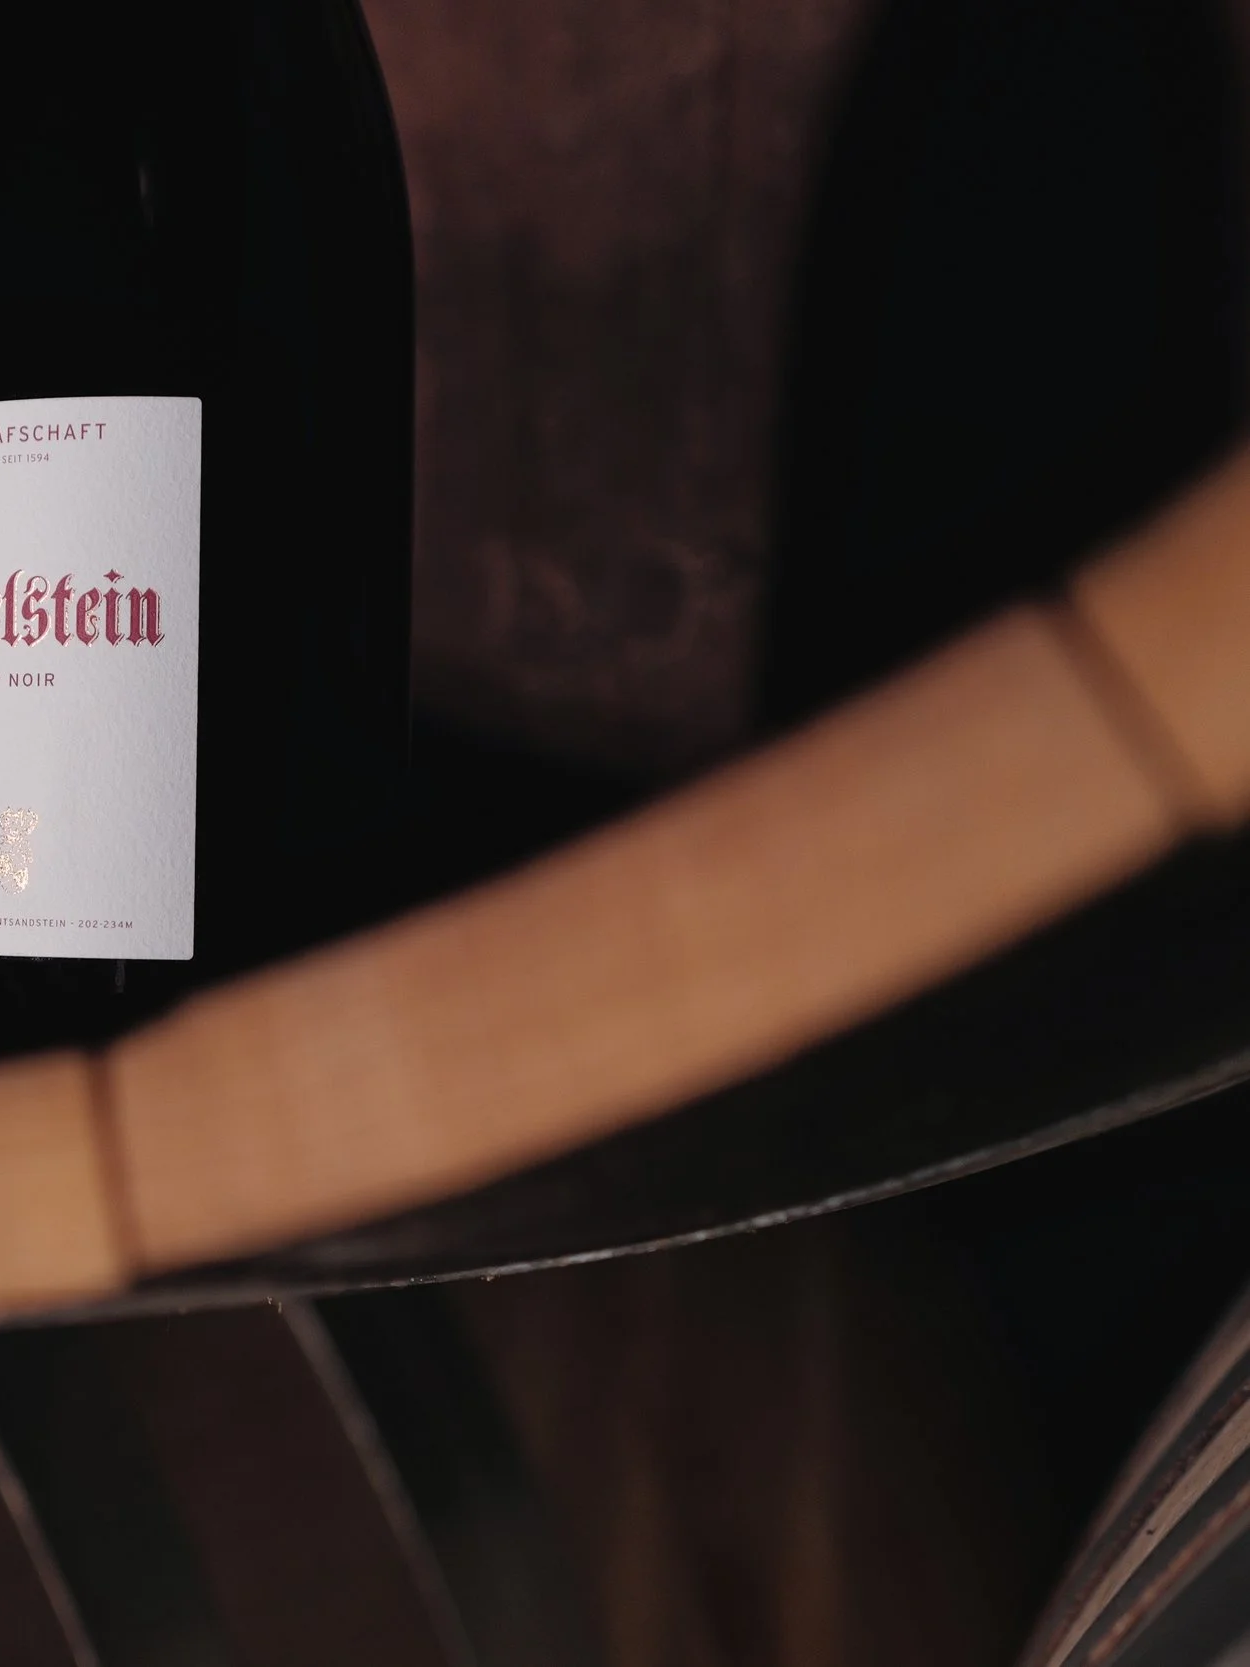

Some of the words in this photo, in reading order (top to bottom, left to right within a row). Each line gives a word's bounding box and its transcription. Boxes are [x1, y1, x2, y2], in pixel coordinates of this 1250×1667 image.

[1, 454, 23, 464] SEIT
[26, 453, 50, 463] 1594
[9, 673, 55, 687] NOIR
[78, 919, 133, 929] 202-234M
